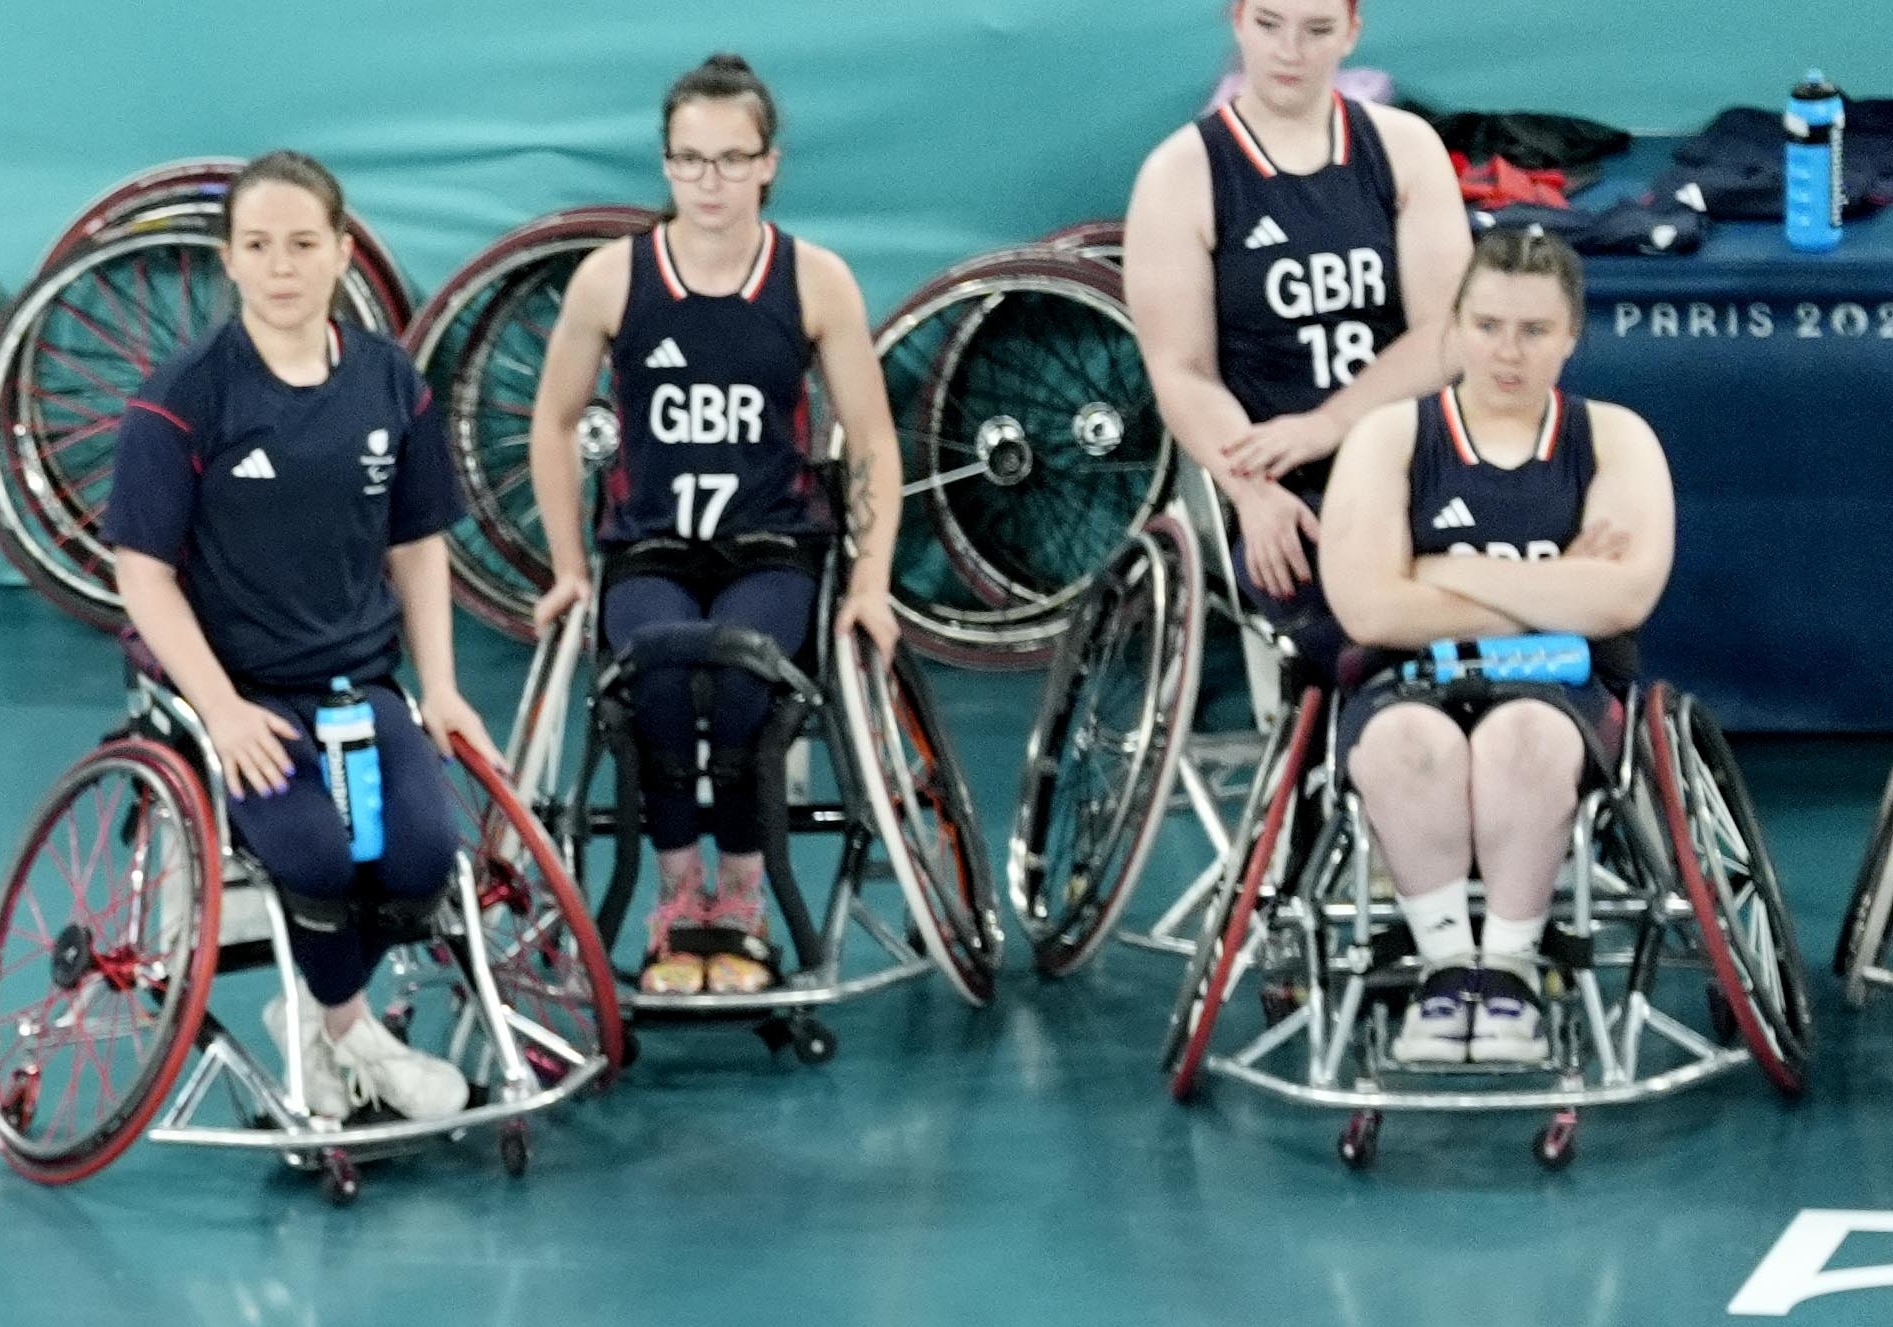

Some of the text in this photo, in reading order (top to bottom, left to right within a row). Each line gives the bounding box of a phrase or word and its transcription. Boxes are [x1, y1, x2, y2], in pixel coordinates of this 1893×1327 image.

[1266, 247, 1387, 319] GBR
[1297, 320, 1378, 389] 18
[1613, 302, 1775, 339] PARIS
[649, 384, 765, 445] GBR
[671, 473, 741, 541] 17
